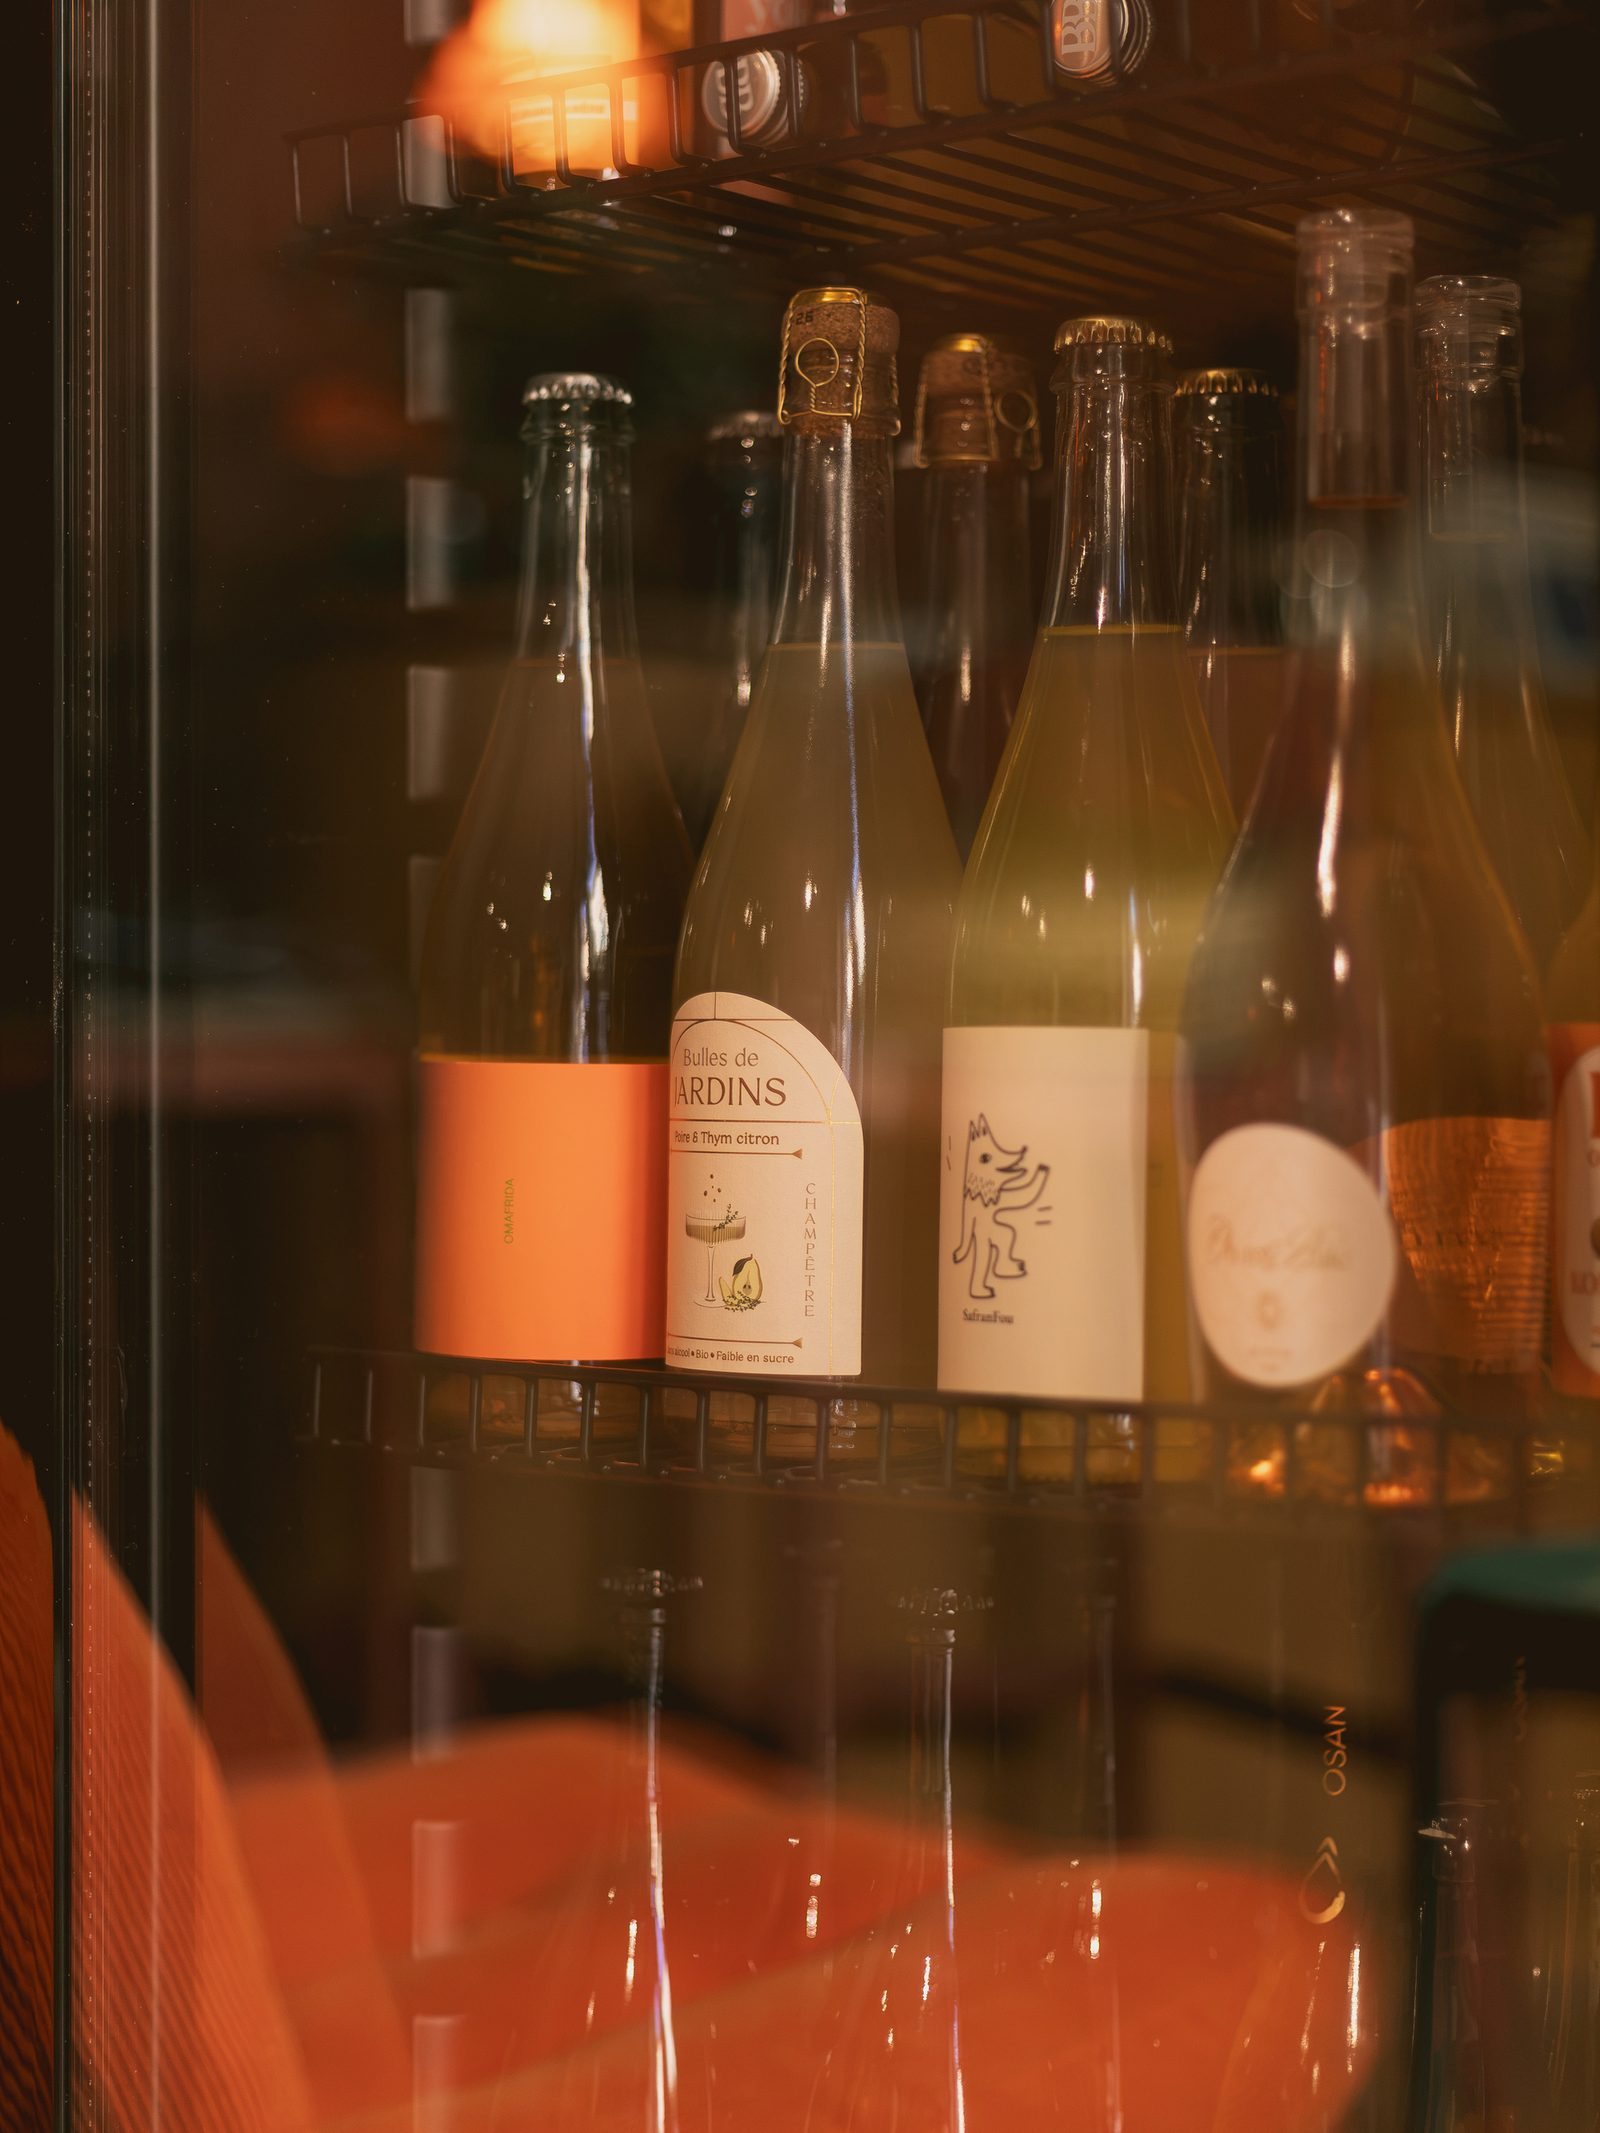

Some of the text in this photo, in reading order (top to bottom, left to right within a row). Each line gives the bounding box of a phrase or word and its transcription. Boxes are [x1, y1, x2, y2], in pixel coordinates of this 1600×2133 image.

[683, 1047, 759, 1067] Bulles de
[674, 1076, 787, 1107] JARDINS
[675, 1130, 690, 1144] Poire
[700, 1130, 733, 1147] Thym
[736, 1131, 780, 1145] citron
[803, 1182, 817, 1317] CHAMPÊTRE
[695, 1349, 709, 1359] Bio
[716, 1350, 744, 1362] Faible
[747, 1354, 760, 1363] en
[763, 1354, 795, 1364] sucre
[1322, 1705, 1348, 1796] OSAN
